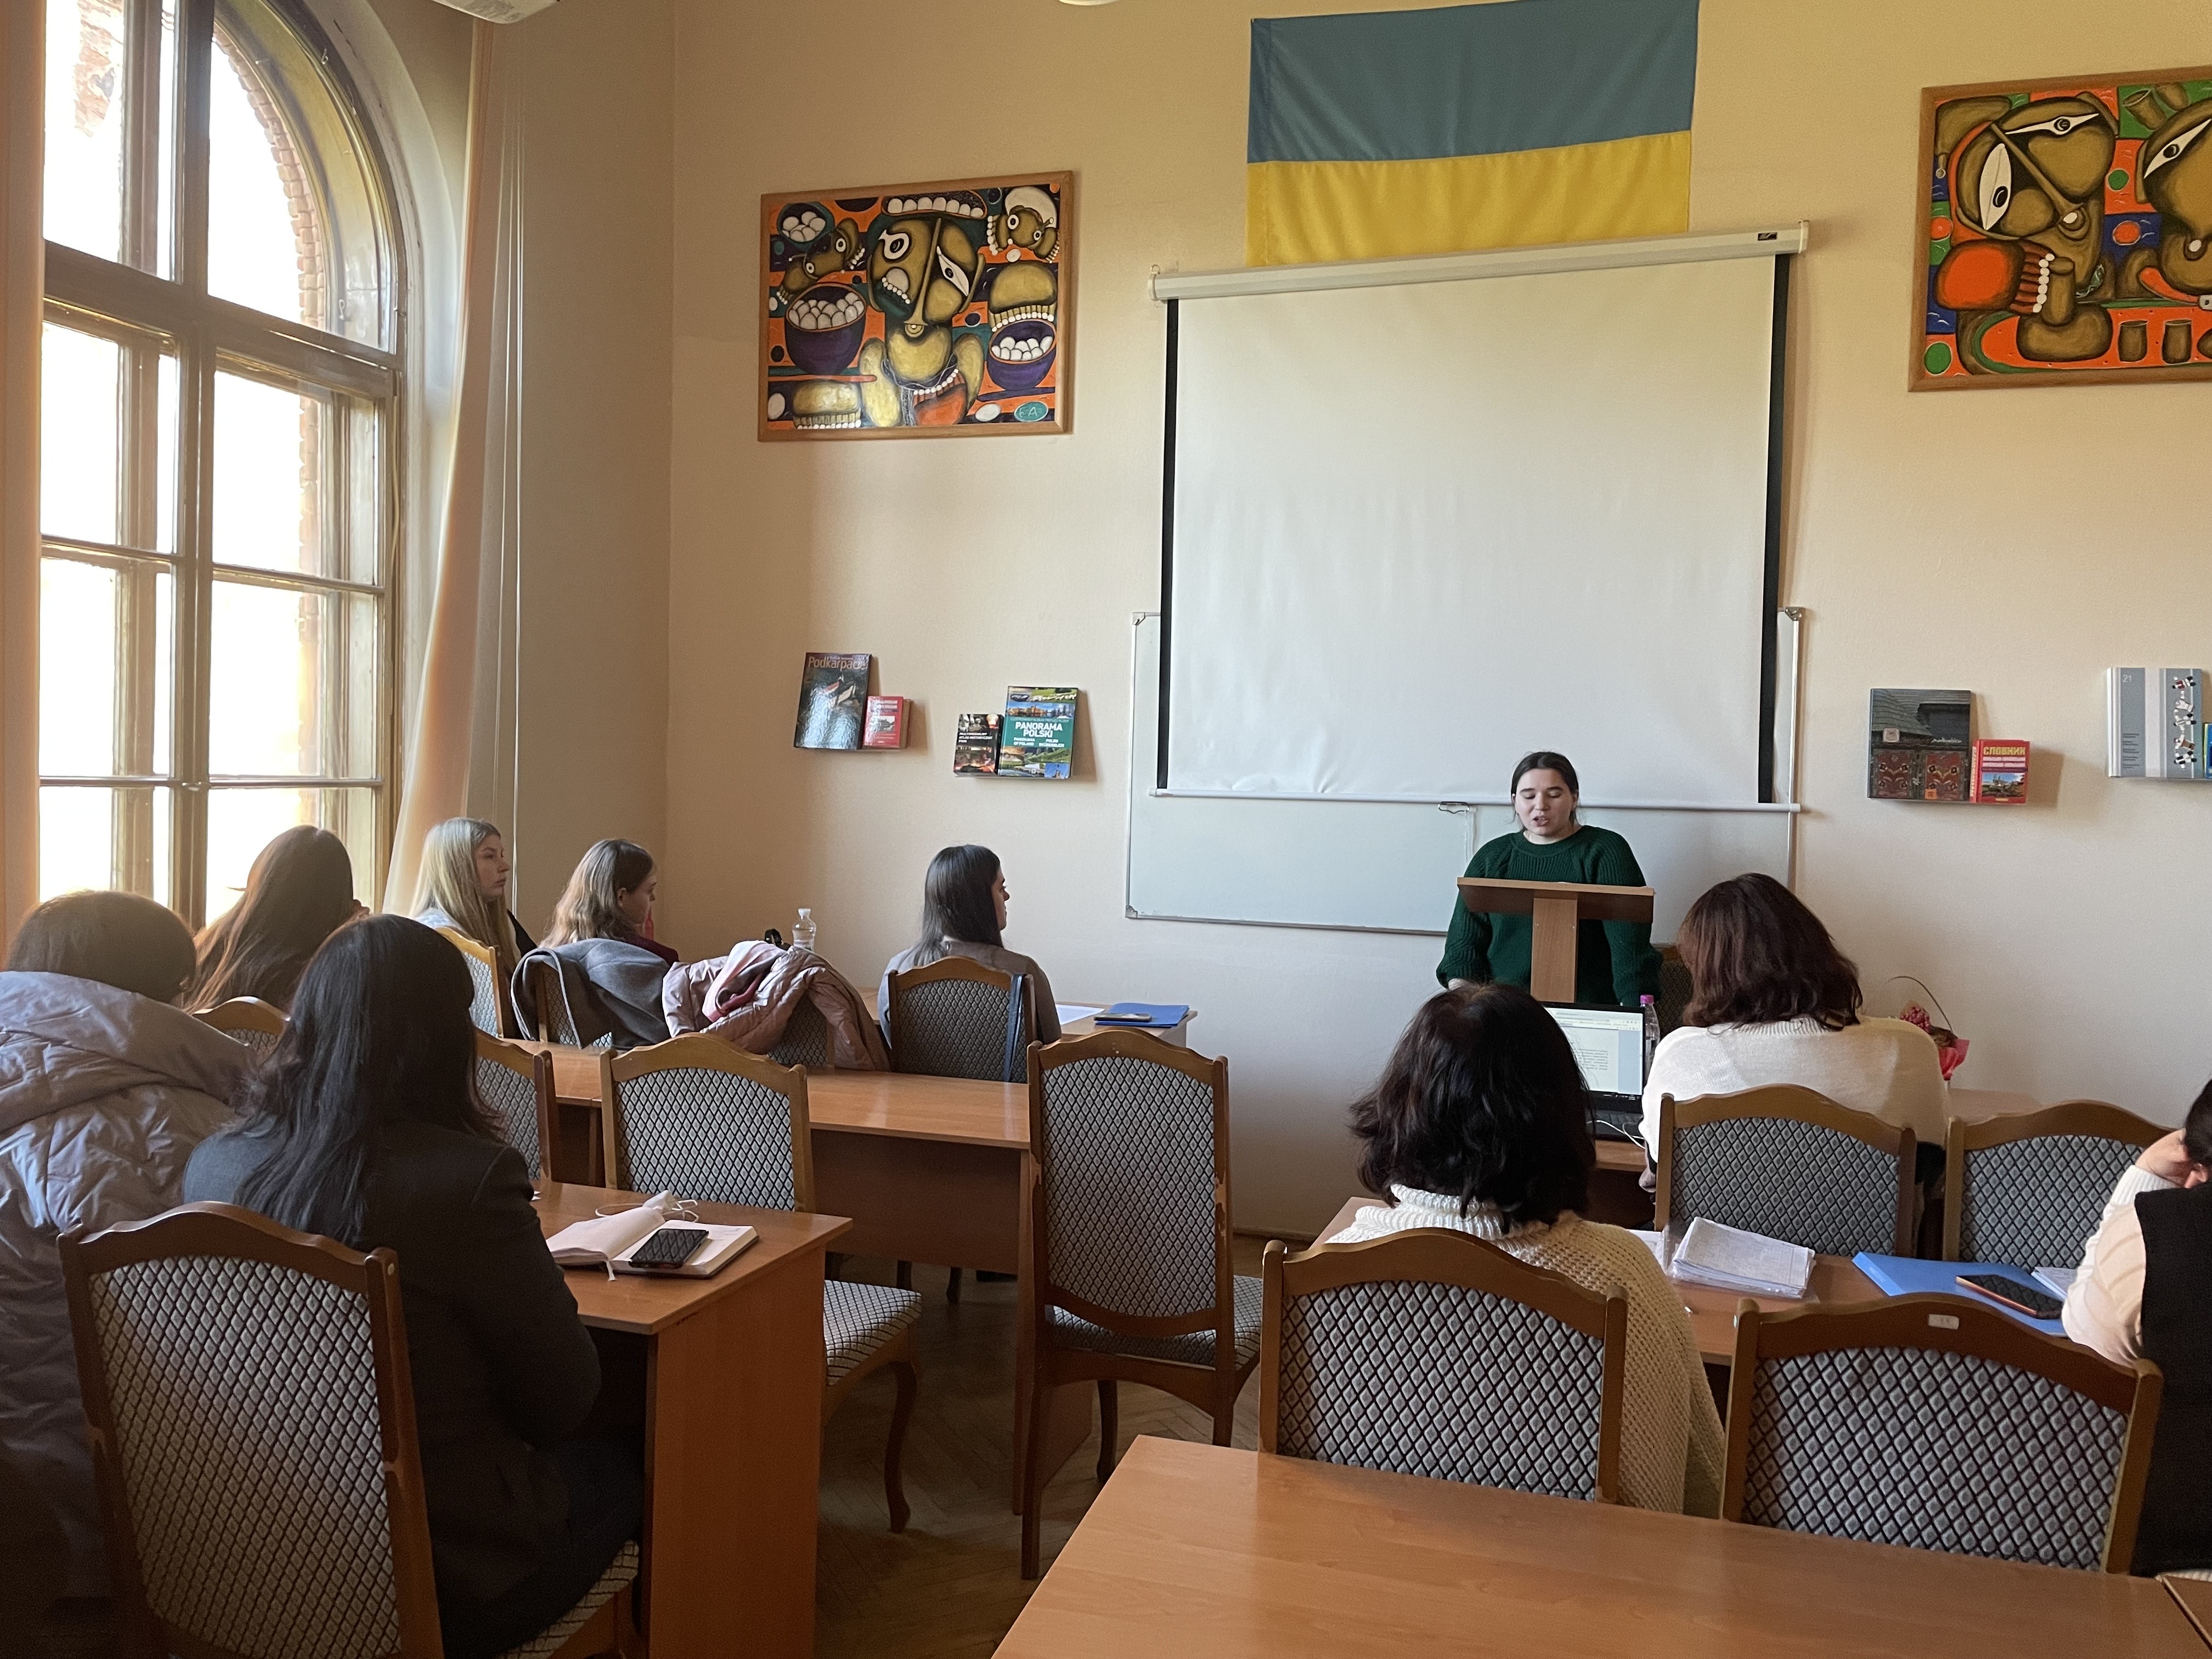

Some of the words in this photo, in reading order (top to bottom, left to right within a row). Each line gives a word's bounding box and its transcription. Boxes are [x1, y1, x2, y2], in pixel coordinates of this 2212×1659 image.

[2123, 674, 2132, 682] 21
[1015, 721, 1063, 731] PANORAMA
[1023, 729, 1053, 738] POLSKI
[1983, 747, 2026, 755] СЛОВНИК
